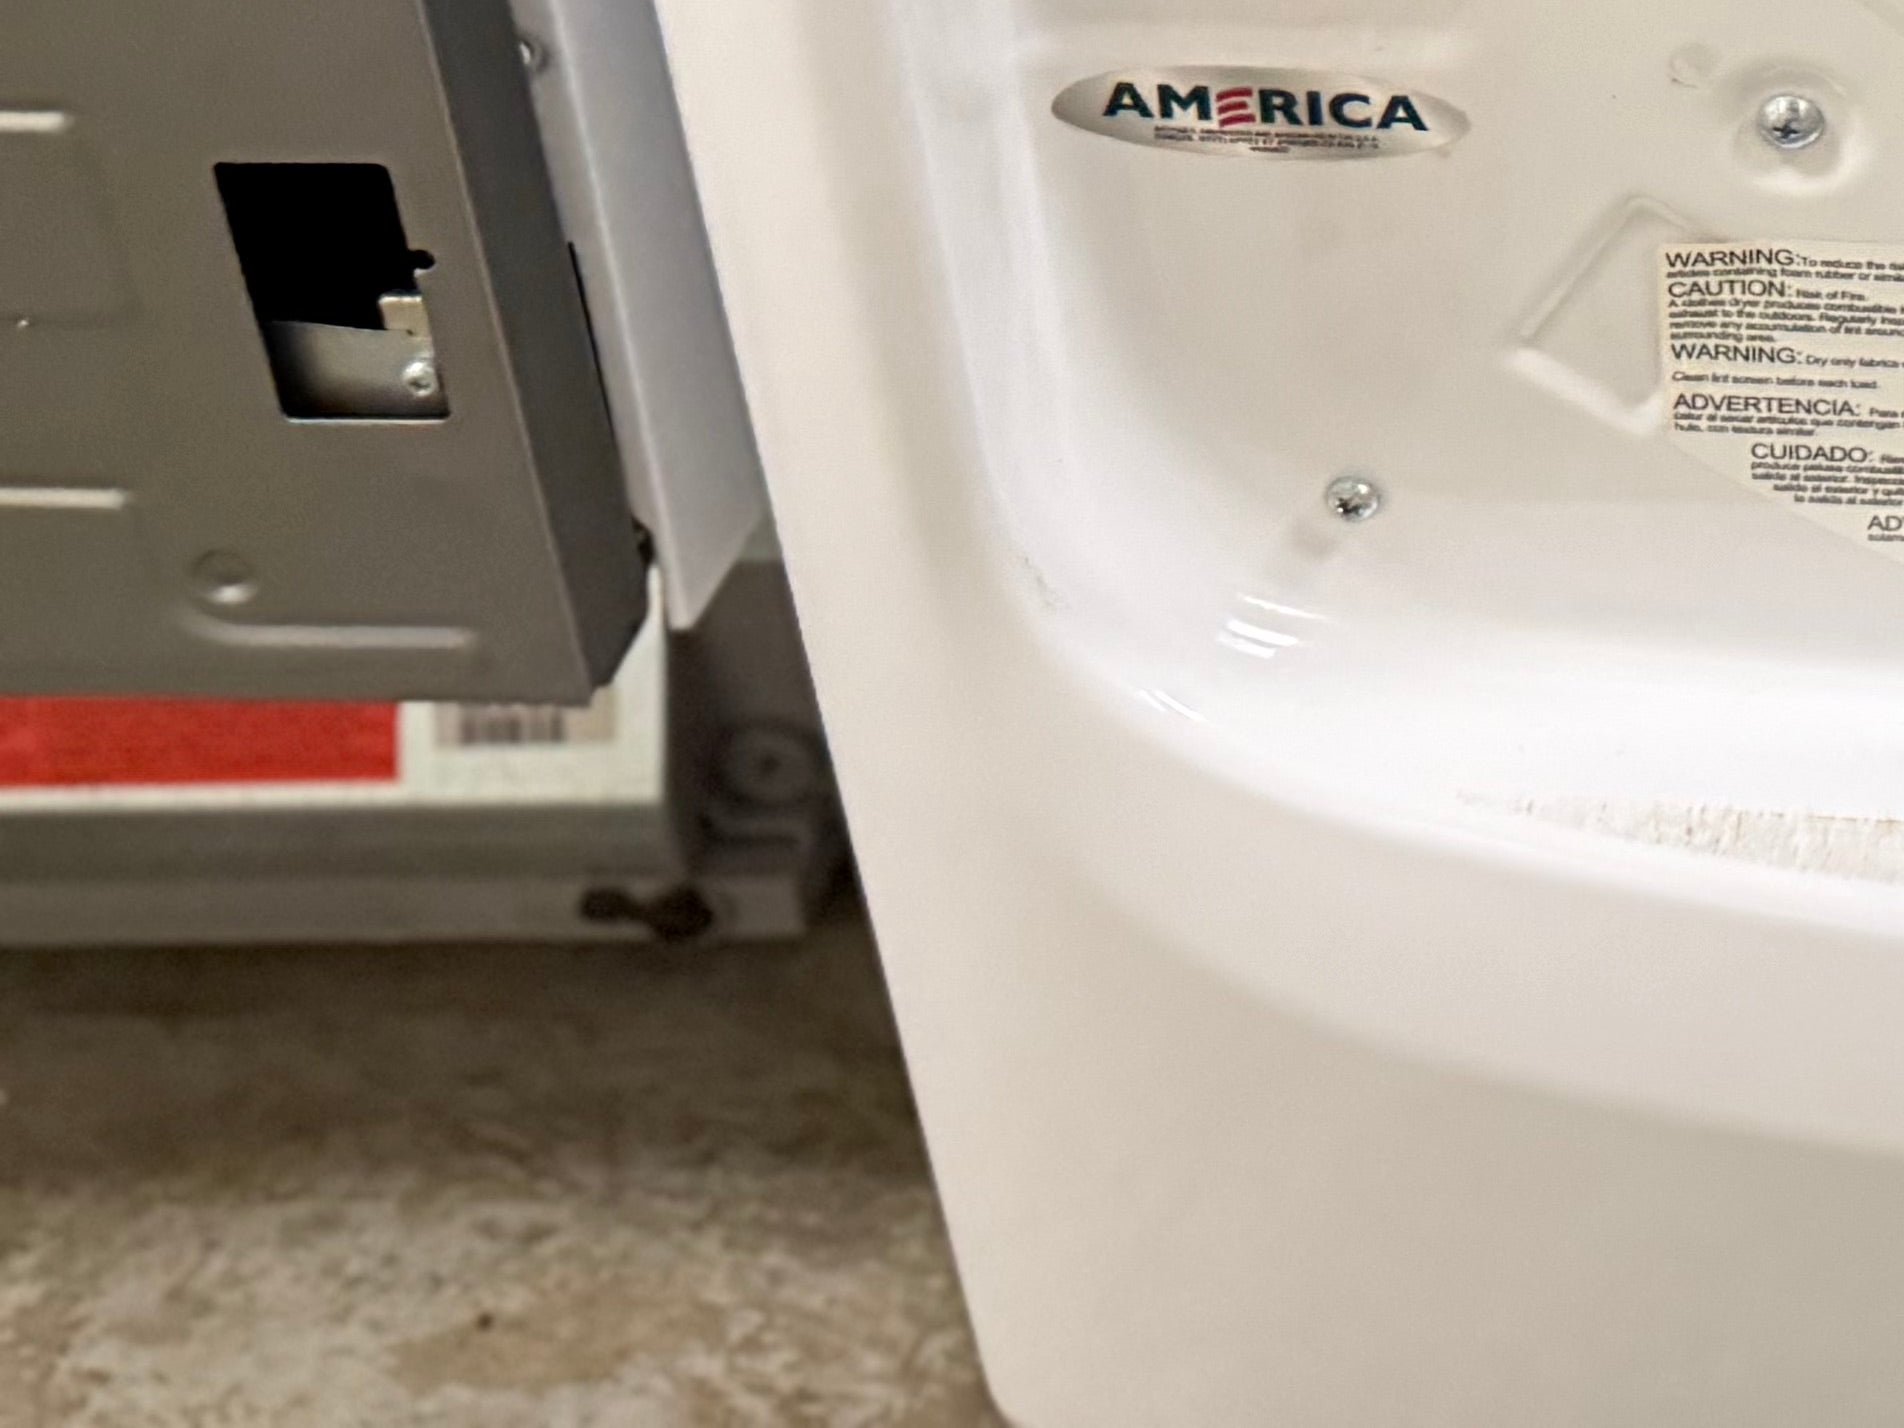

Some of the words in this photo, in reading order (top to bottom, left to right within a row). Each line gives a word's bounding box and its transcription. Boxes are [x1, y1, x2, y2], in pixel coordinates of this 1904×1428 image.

[1102, 80, 1430, 132] AMERICA
[1666, 247, 1801, 268] WARNING:
[1667, 278, 1792, 300] CAUTION:
[1671, 343, 1803, 366] WARNING:
[1673, 393, 1861, 418] ADVERTENCIA:
[1750, 442, 1874, 465] CUIDADO:
